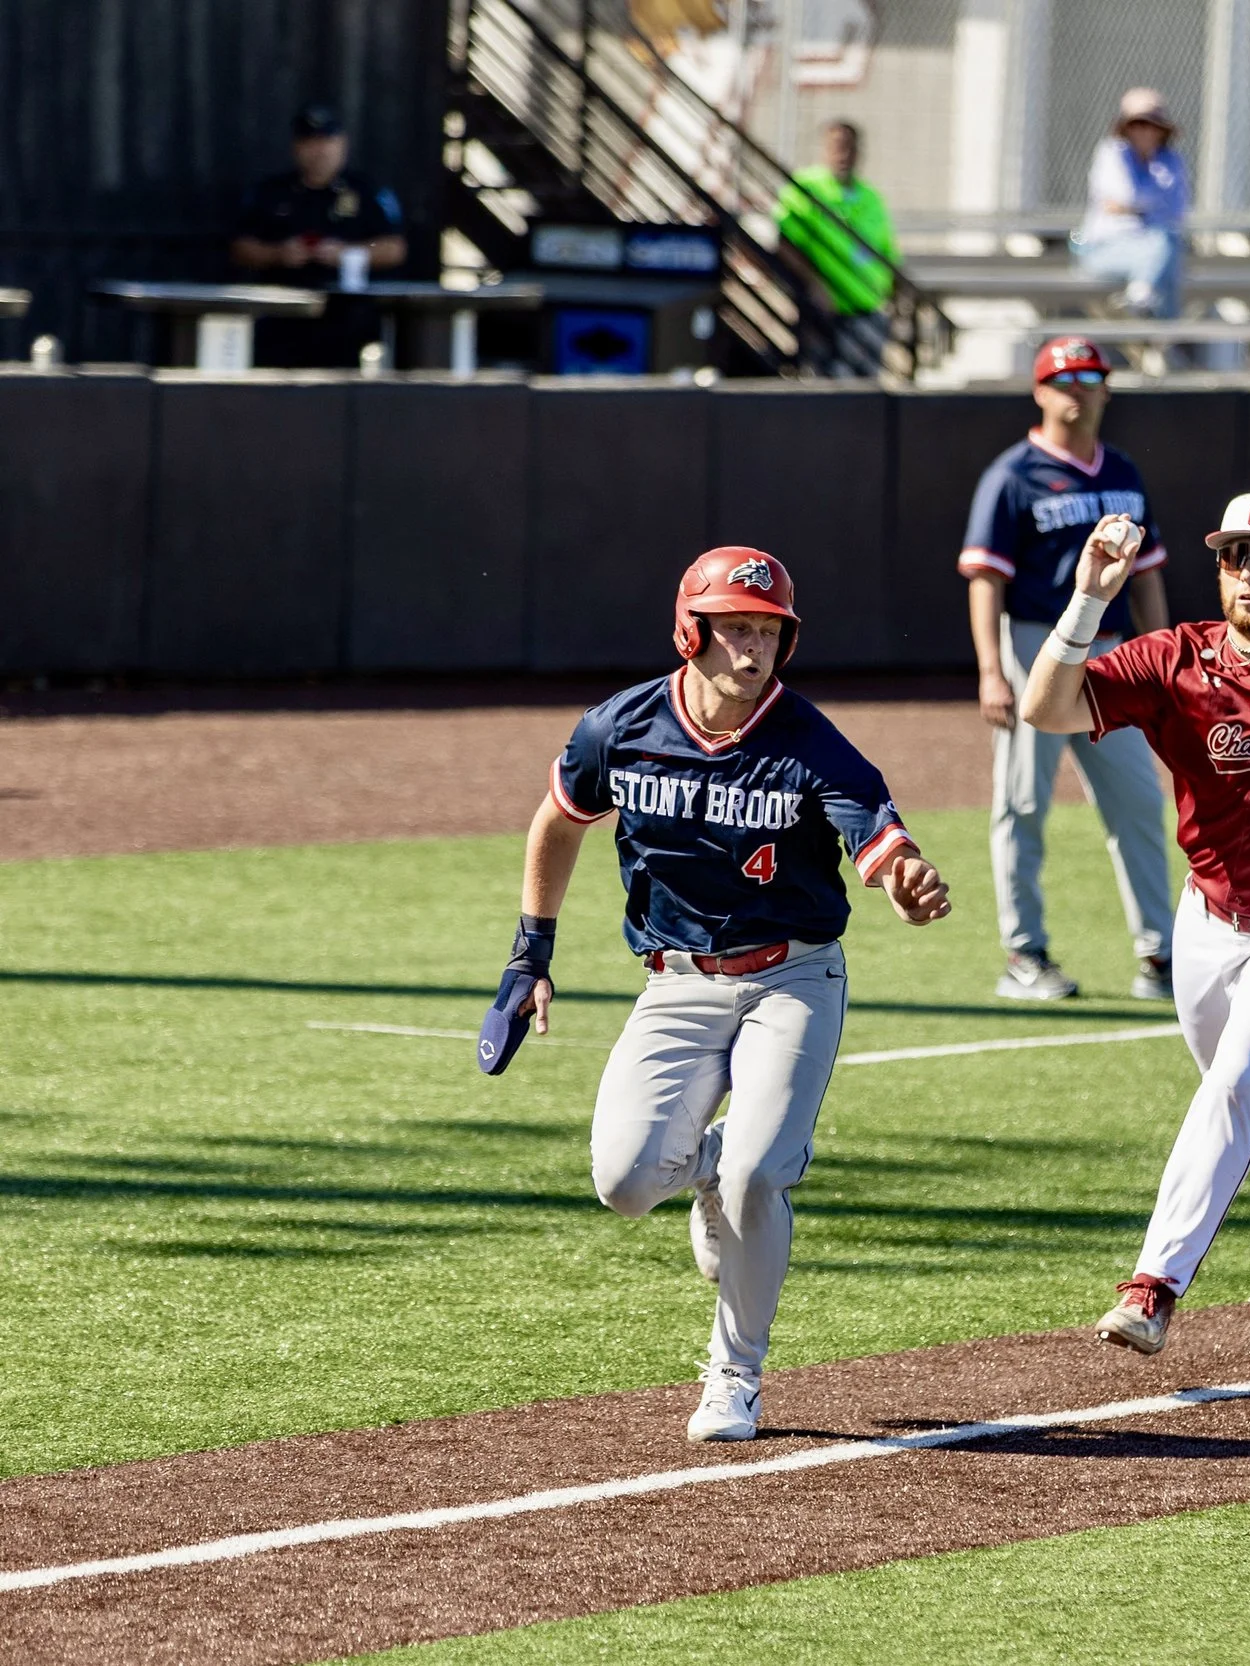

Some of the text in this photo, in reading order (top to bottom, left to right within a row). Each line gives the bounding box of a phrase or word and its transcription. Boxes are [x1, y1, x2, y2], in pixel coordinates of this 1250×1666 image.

[609, 770, 804, 830] STONY BROOK
[741, 843, 778, 885] 4
